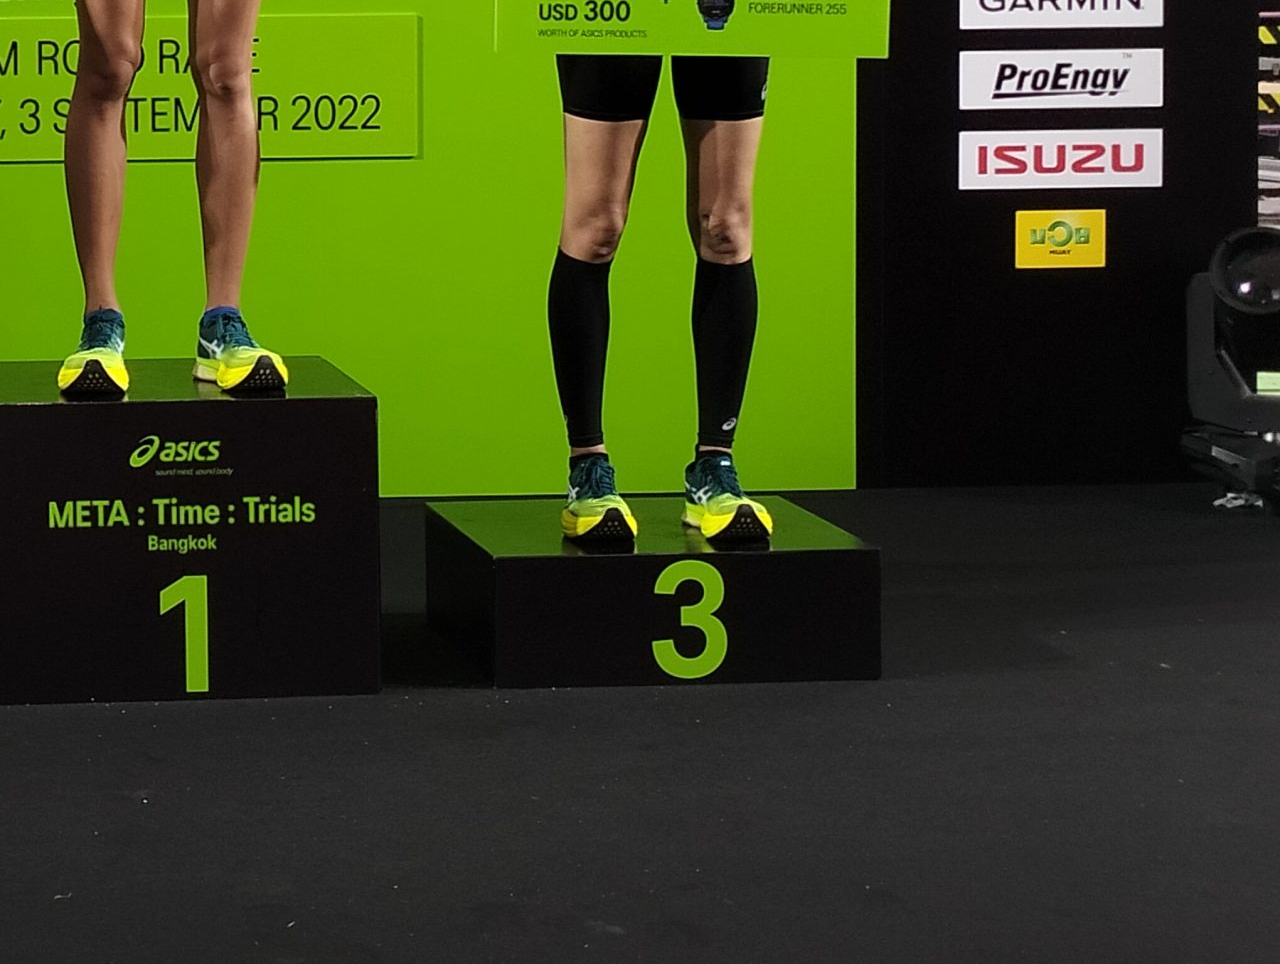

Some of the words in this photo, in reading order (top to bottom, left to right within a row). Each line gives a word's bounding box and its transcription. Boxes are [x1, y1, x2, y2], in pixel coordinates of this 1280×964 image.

[538, 2, 578, 21] USD
[583, 0, 631, 22] 300
[748, 2, 823, 15] FORERUNNER
[825, 3, 847, 15] 255
[538, 28, 568, 37] WORTH
[605, 29, 648, 39] PRODUCTS
[994, 63, 1130, 96] ProEngy
[19, 98, 41, 134] 3
[53, 95, 279, 134] STEMR
[290, 94, 381, 132] 2022
[977, 143, 1145, 175] ISUZU
[48, 500, 130, 528] META
[152, 498, 220, 525] Time
[243, 495, 316, 524] Trials
[147, 534, 216, 554] Bangkok
[159, 574, 209, 693] 1
[652, 559, 728, 679] 3
